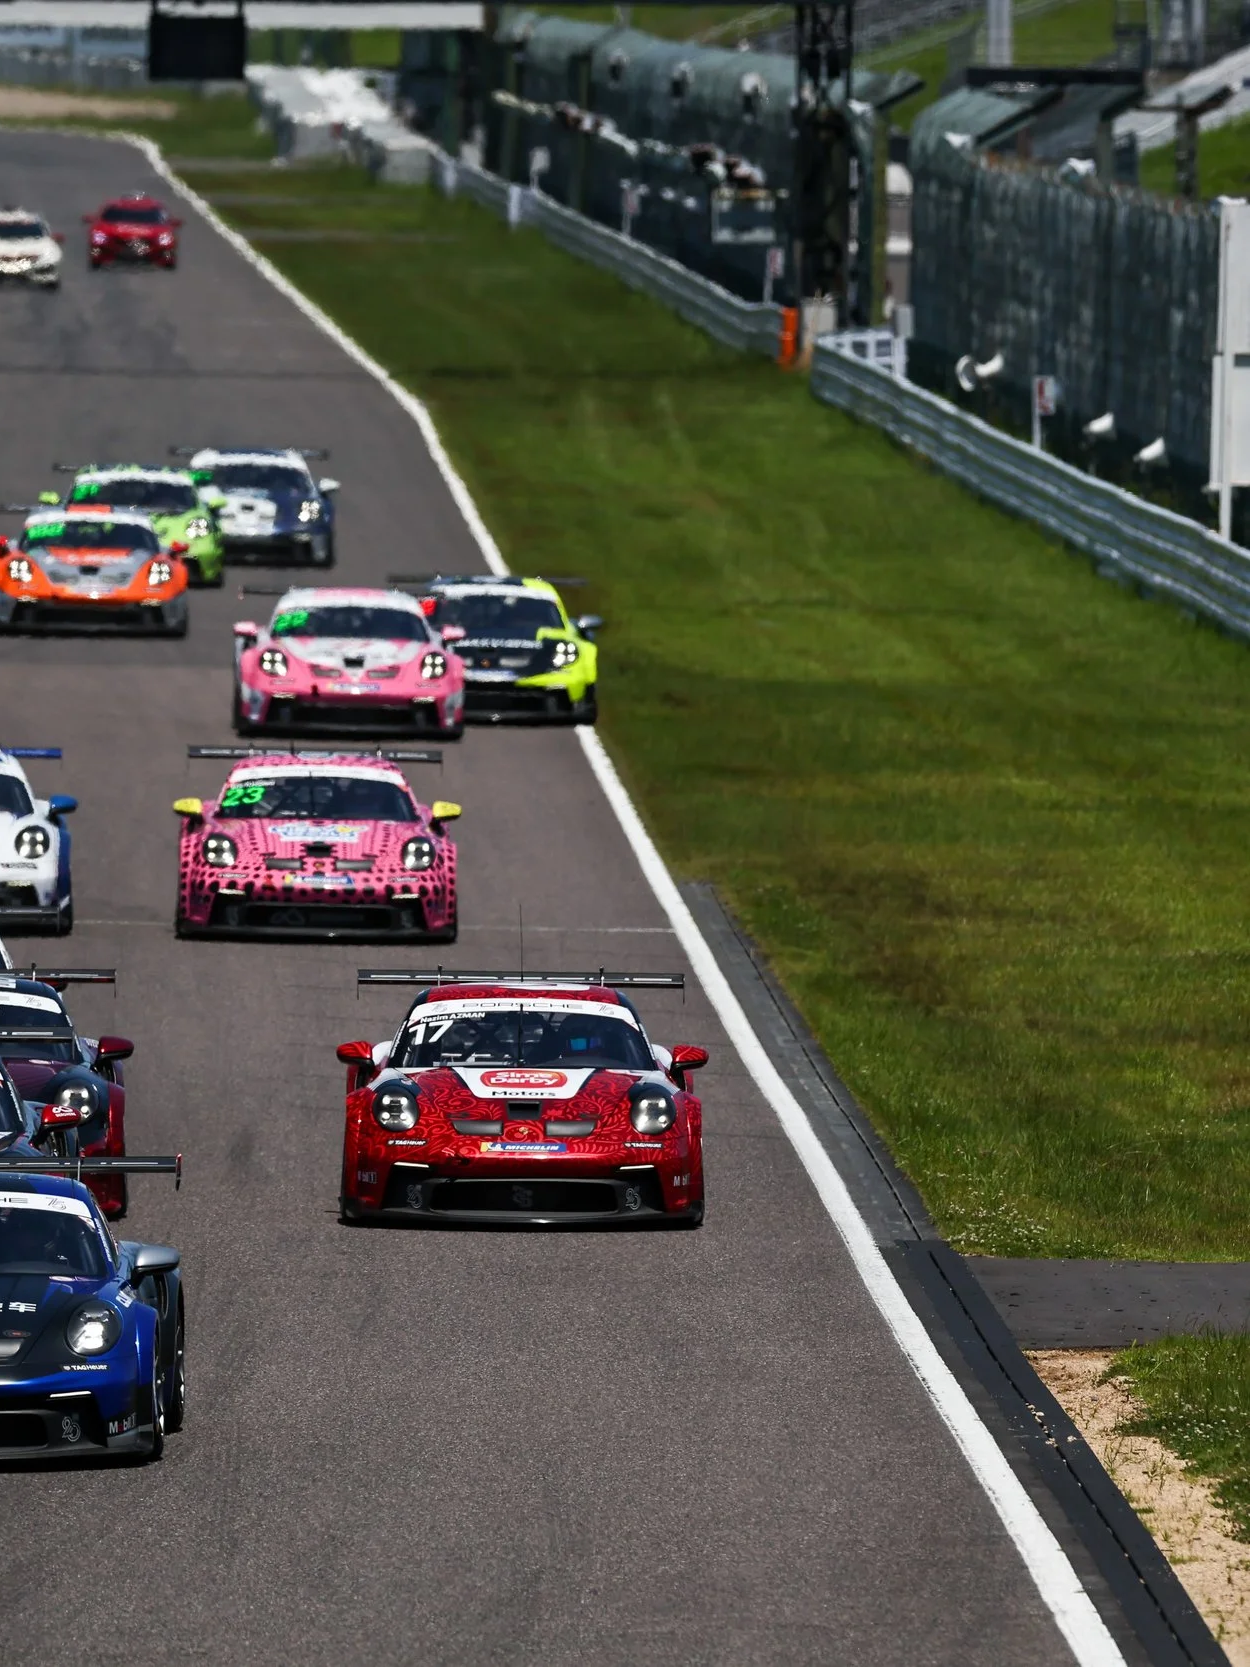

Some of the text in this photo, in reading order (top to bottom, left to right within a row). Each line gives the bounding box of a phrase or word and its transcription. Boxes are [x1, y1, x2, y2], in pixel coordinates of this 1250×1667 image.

[222, 787, 266, 807] 23
[419, 1011, 486, 1024] Nazim AZMAN
[408, 1020, 454, 1046] 17
[495, 1070, 554, 1079] Sime
[490, 1076, 560, 1086] Darby
[492, 1090, 557, 1098] Motors
